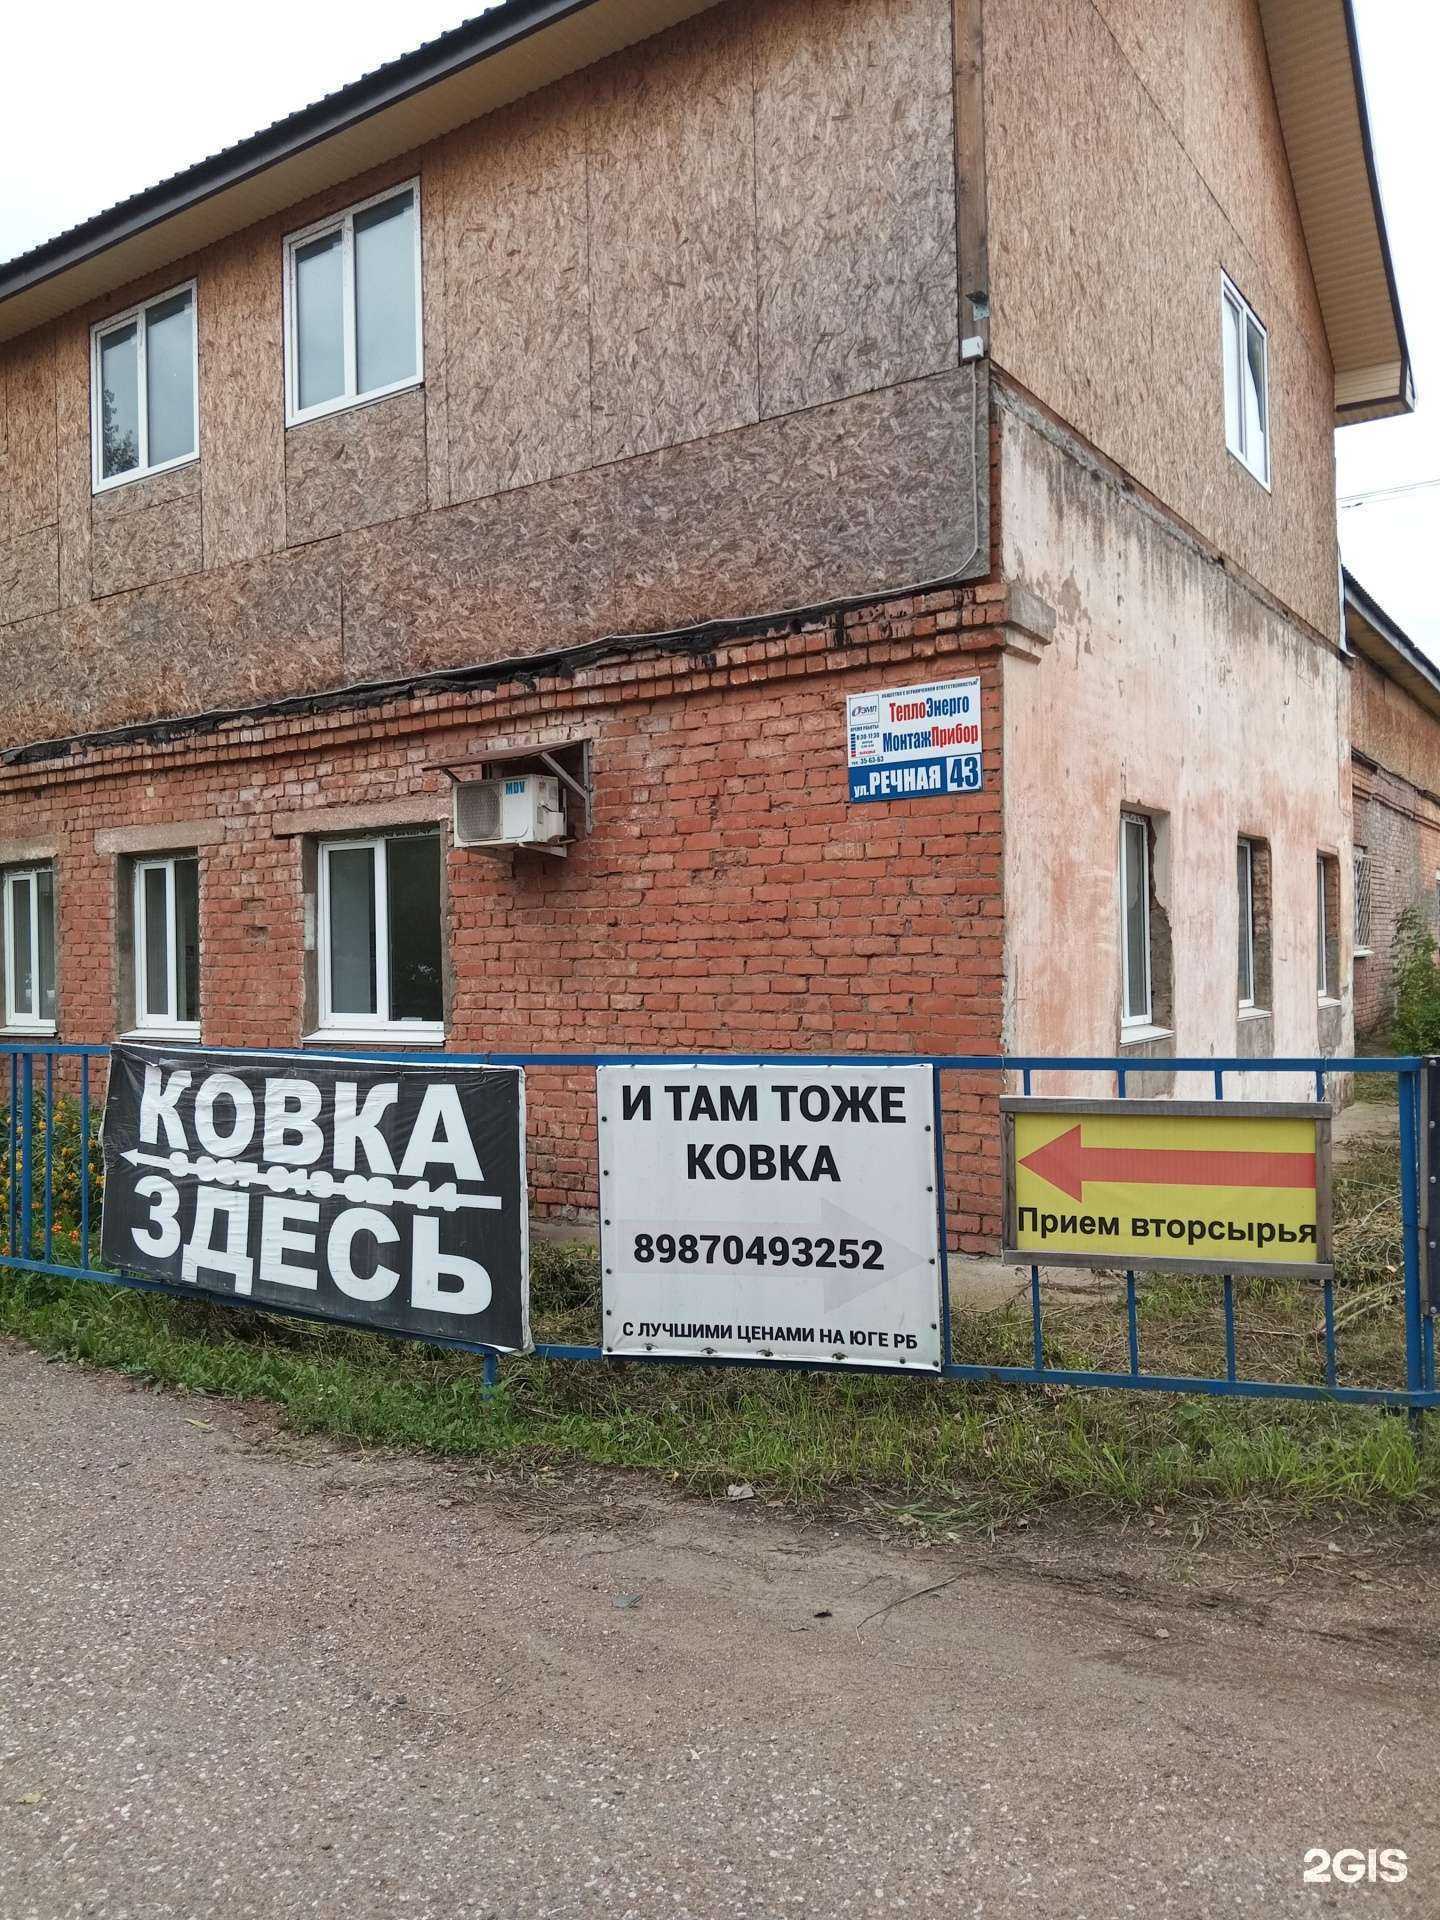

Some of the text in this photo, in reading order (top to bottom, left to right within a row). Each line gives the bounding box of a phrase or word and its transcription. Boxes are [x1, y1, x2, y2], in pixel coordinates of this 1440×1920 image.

[889, 696, 970, 722] ТеплоЭнерго
[882, 723, 979, 753] МонтажПрибор
[505, 780, 526, 795] MDV
[950, 757, 979, 788] 43
[622, 1085, 906, 1123] И ТАМ ТОЖЕ
[139, 1064, 485, 1182] КОВКА
[687, 1143, 841, 1182] КОВКА
[130, 1175, 492, 1315] ЗДЕСЬ
[1018, 1207, 1317, 1248] Прием вторсырья
[633, 1234, 885, 1271] 89870493252
[622, 1322, 918, 1349] С ЛУЧШИМИ ЦЕНАМИ НА ЮГЕ РБ
